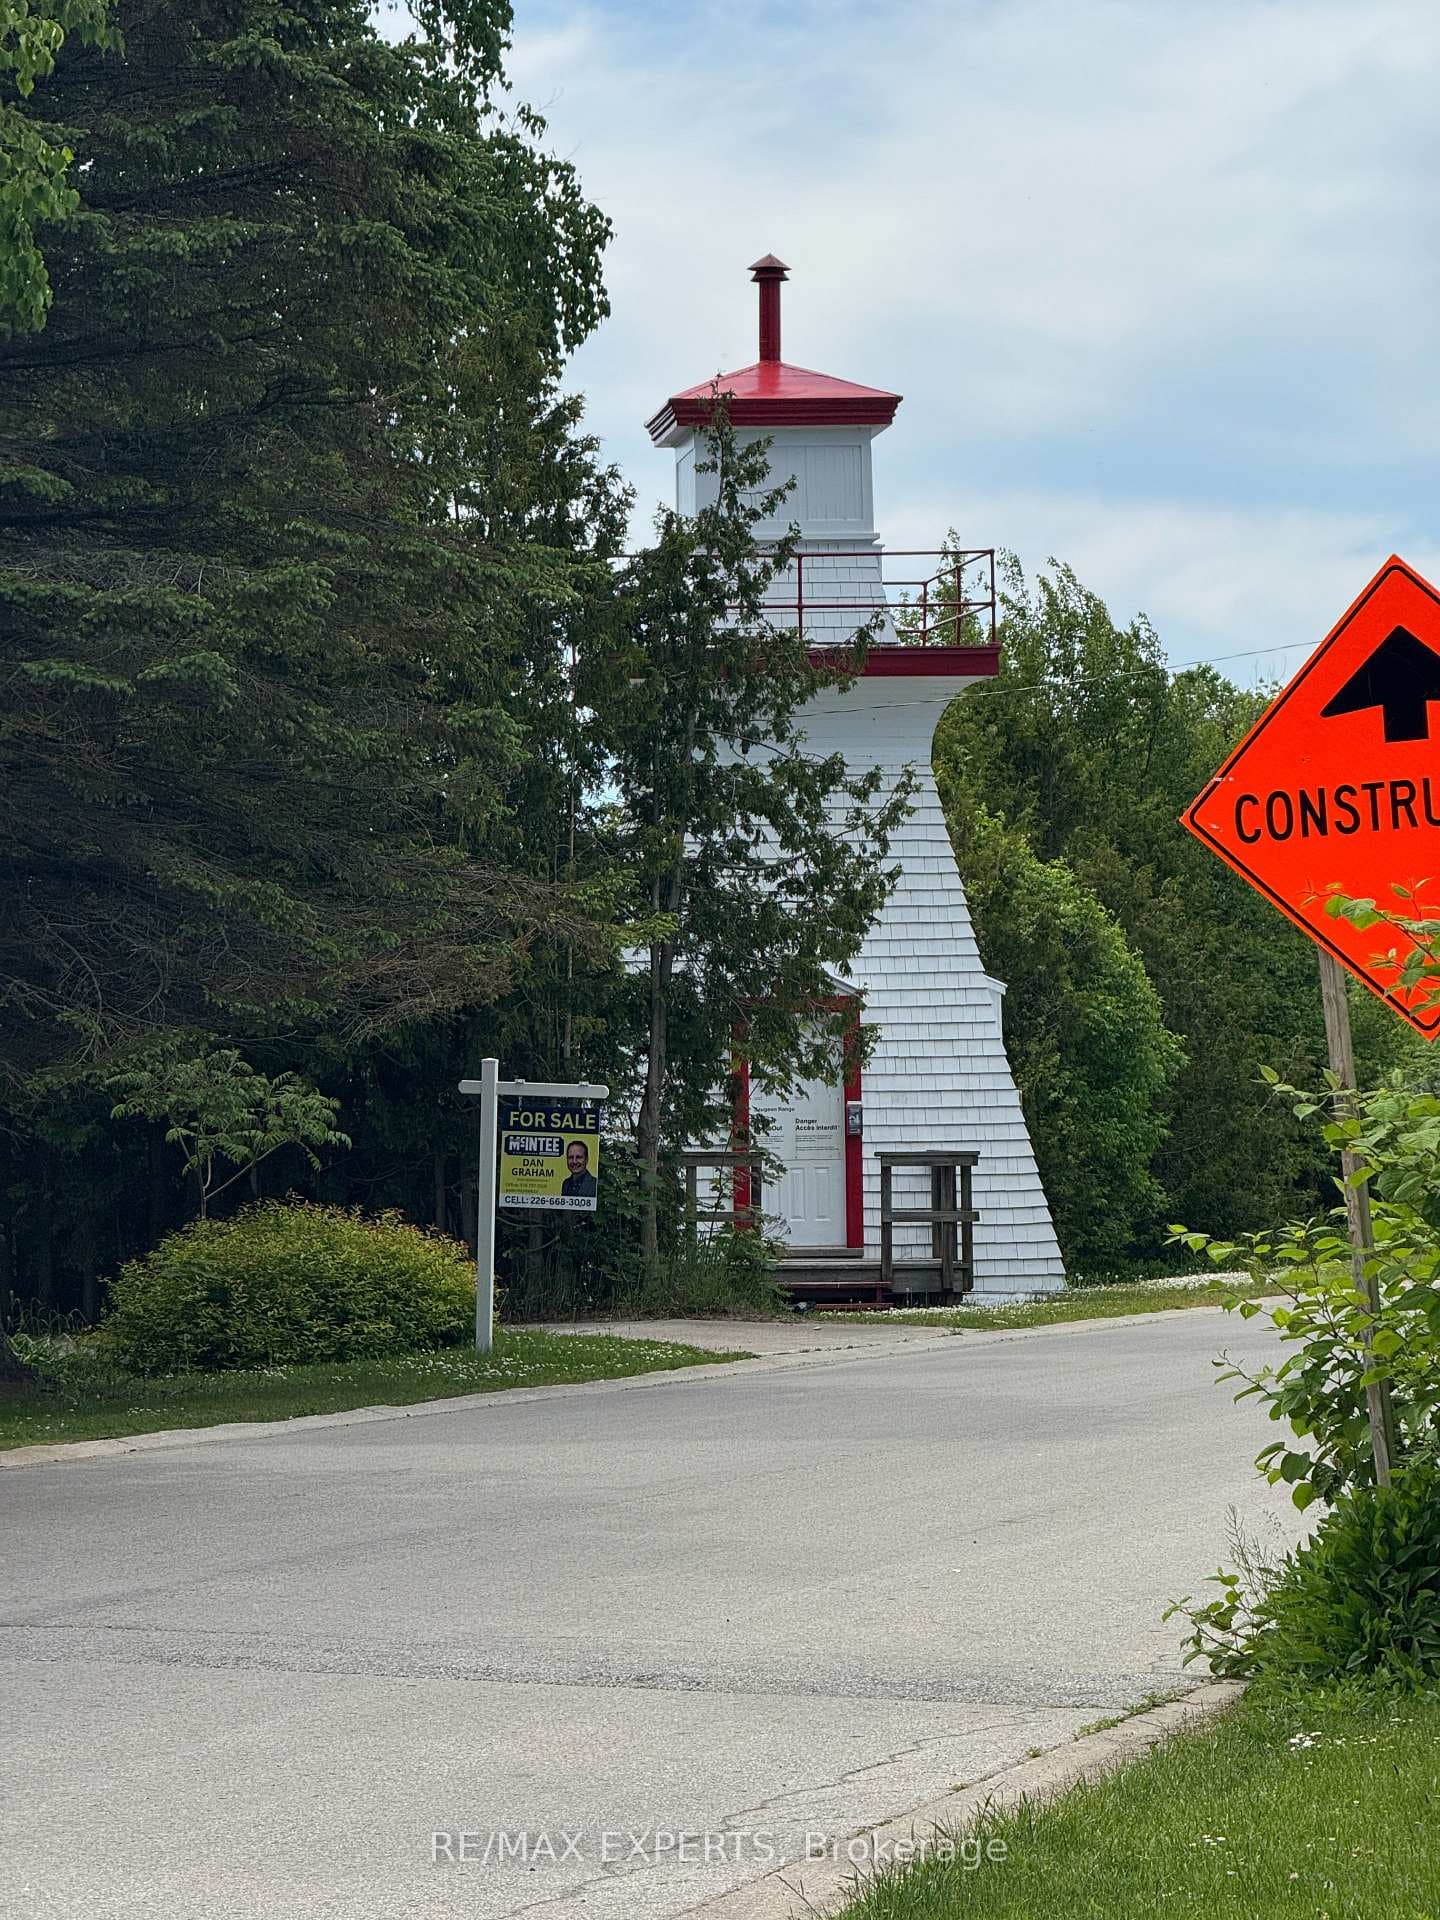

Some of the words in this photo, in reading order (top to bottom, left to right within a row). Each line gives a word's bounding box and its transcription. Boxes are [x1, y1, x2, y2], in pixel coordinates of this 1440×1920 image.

[1235, 777, 1440, 844] CONSTRU
[509, 1111, 546, 1128] FOR
[550, 1112, 596, 1129] SALE
[522, 1158, 544, 1167] DAN
[511, 1167, 554, 1177] GRAHAM
[504, 1195, 529, 1204] CELL:
